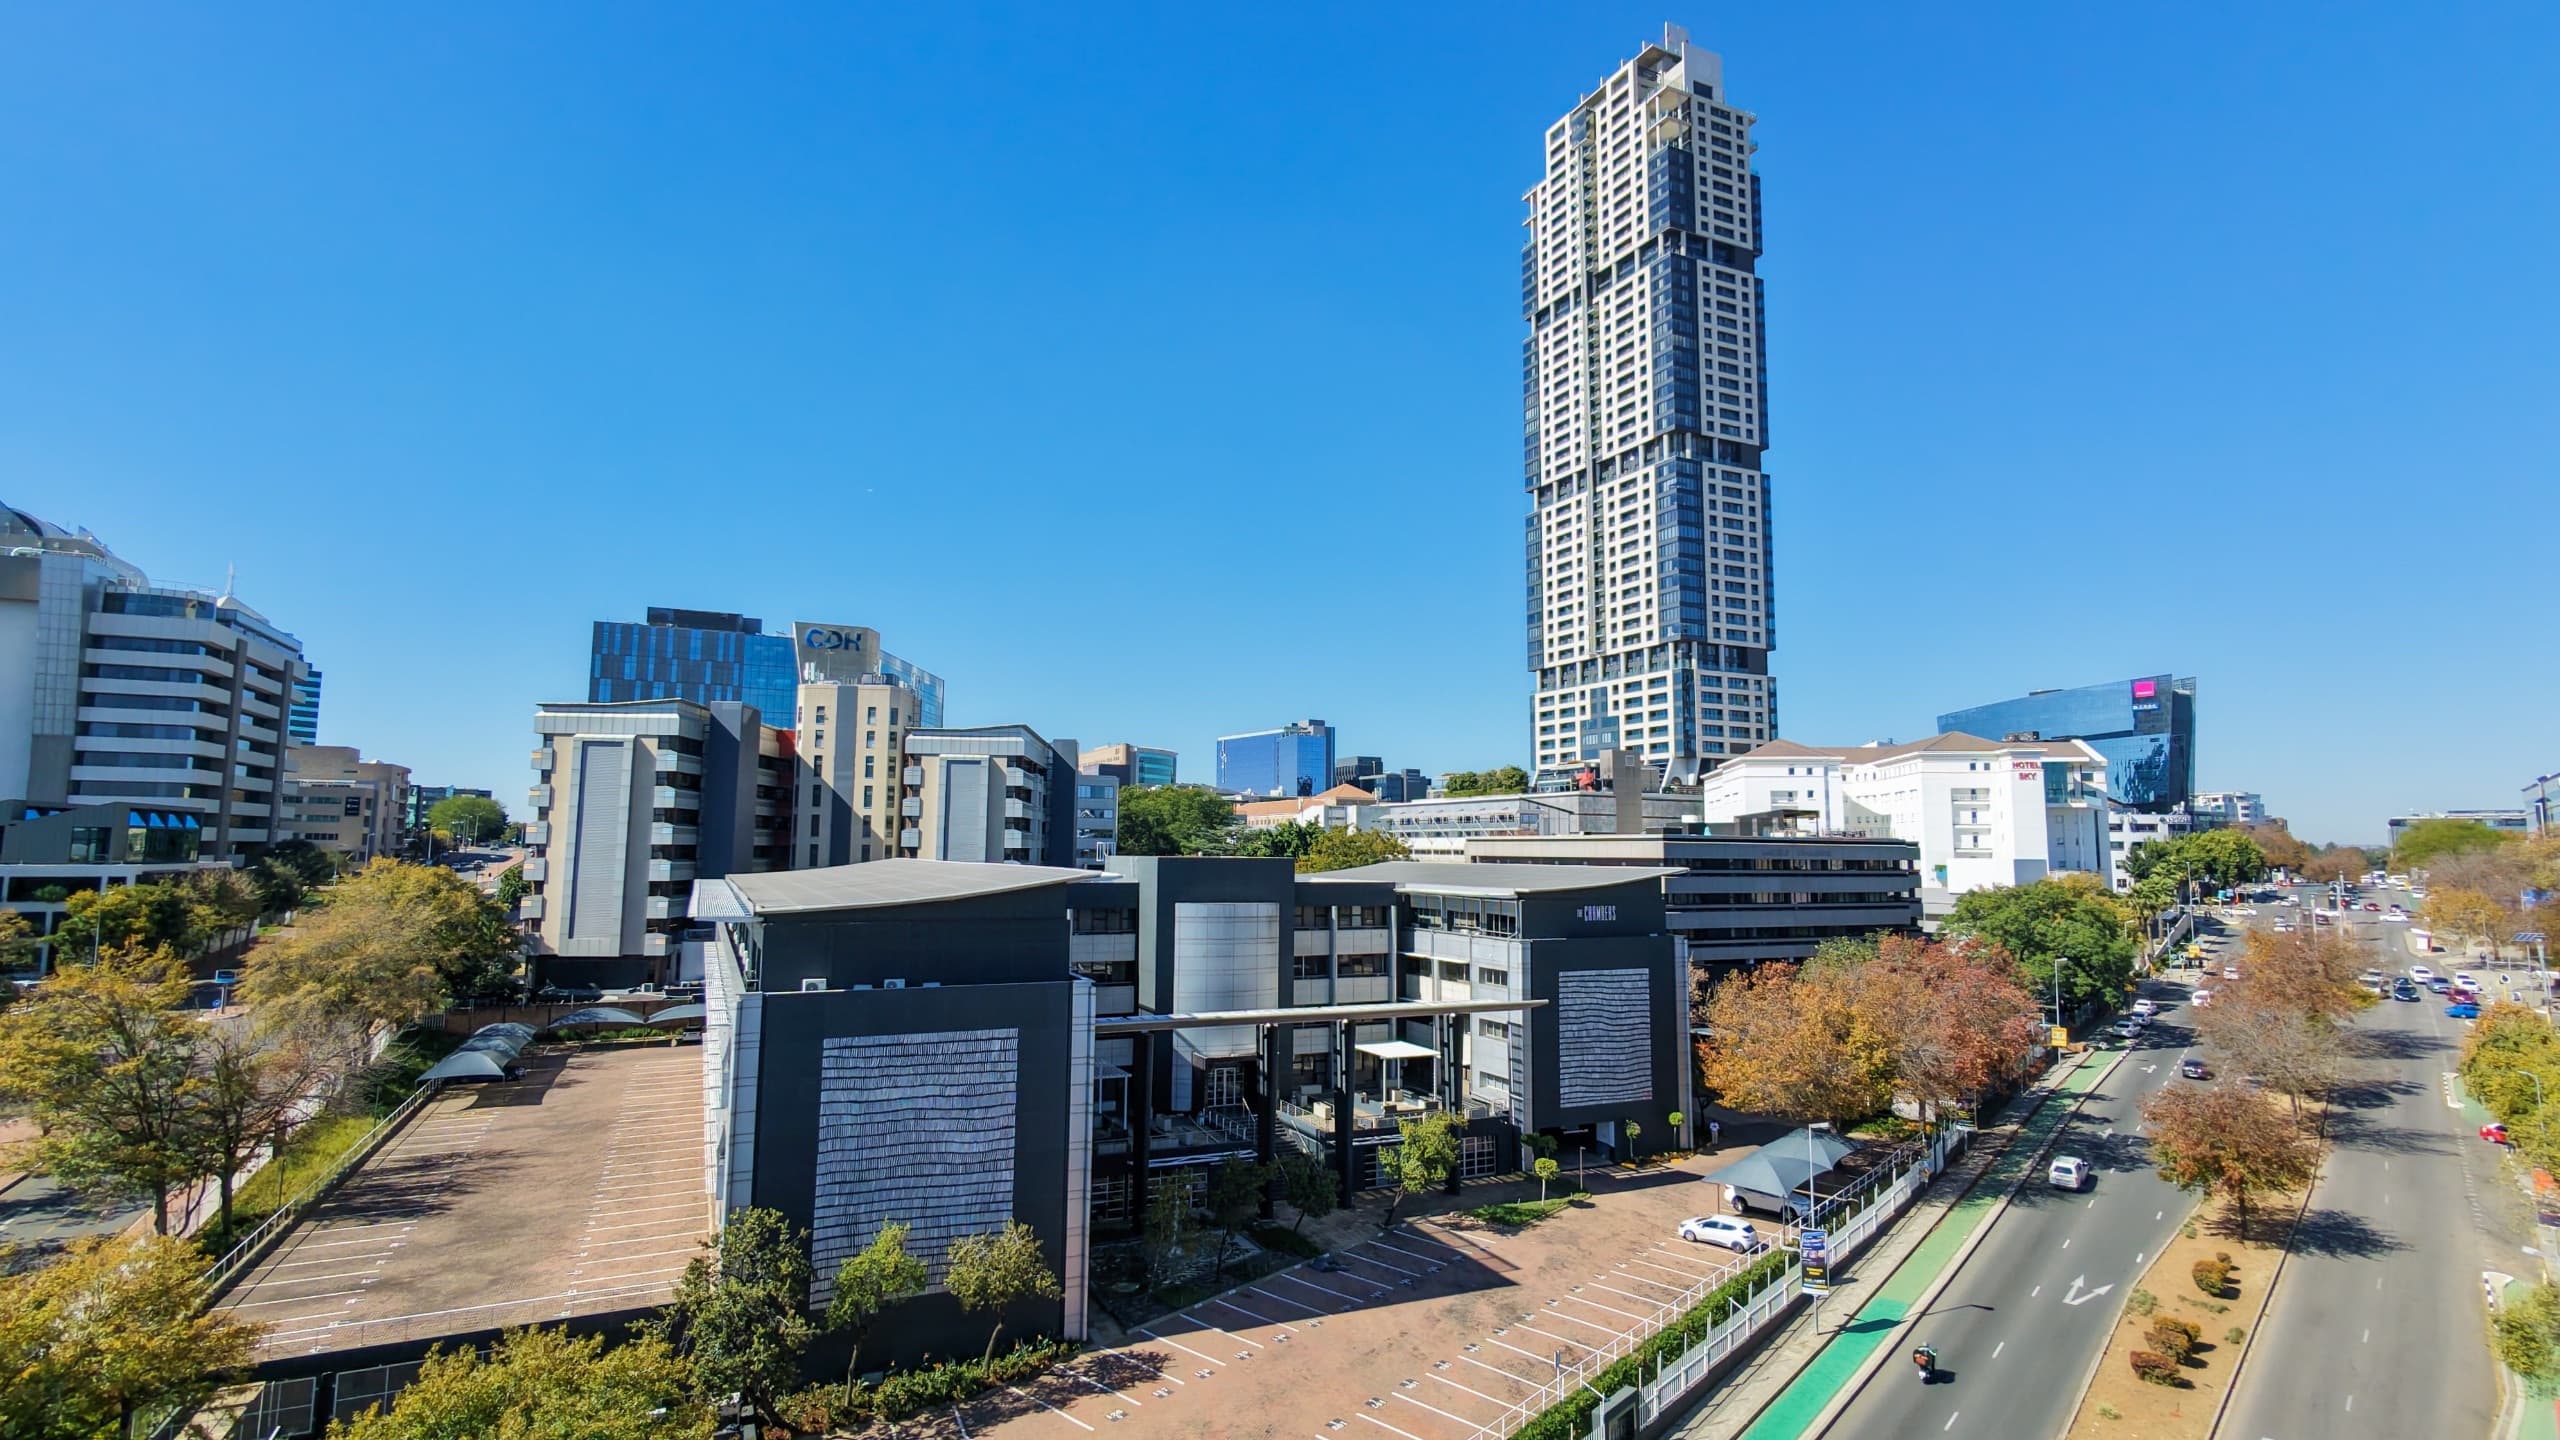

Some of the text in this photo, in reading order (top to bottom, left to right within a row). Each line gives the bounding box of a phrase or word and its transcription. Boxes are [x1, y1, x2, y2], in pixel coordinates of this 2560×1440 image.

[806, 628, 862, 651] CDH
[2012, 761, 2040, 769] HOTEL
[2019, 772, 2037, 780] SKY
